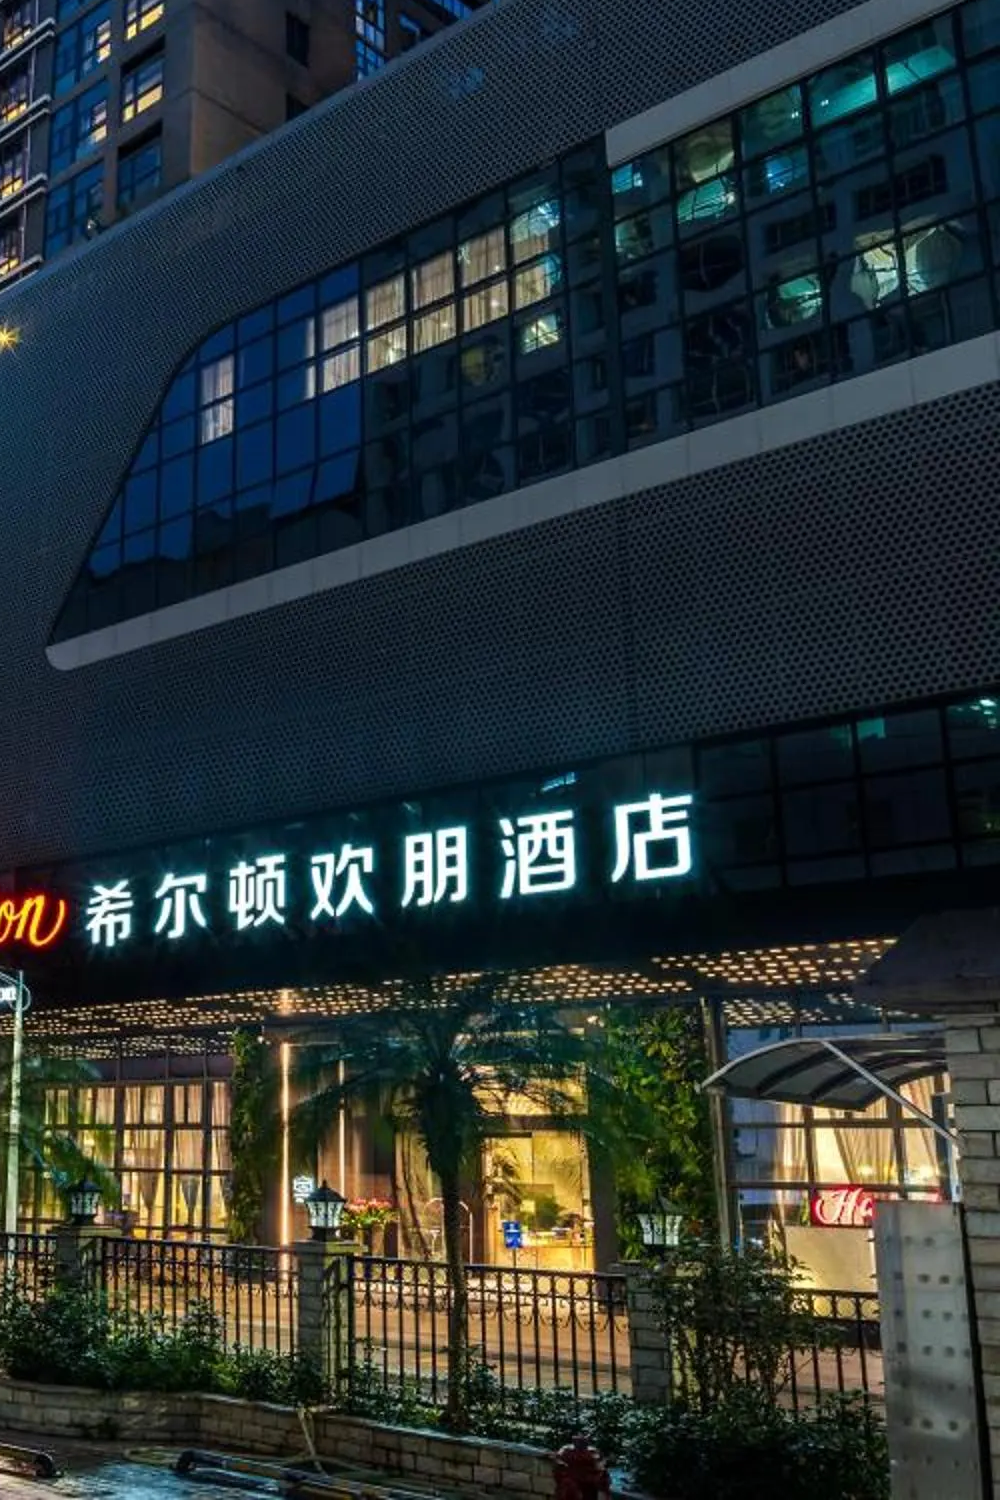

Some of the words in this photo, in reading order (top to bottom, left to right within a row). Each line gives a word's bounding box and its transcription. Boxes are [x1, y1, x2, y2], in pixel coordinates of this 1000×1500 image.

[85, 792, 694, 948] 希尔顿欢朋酒店
